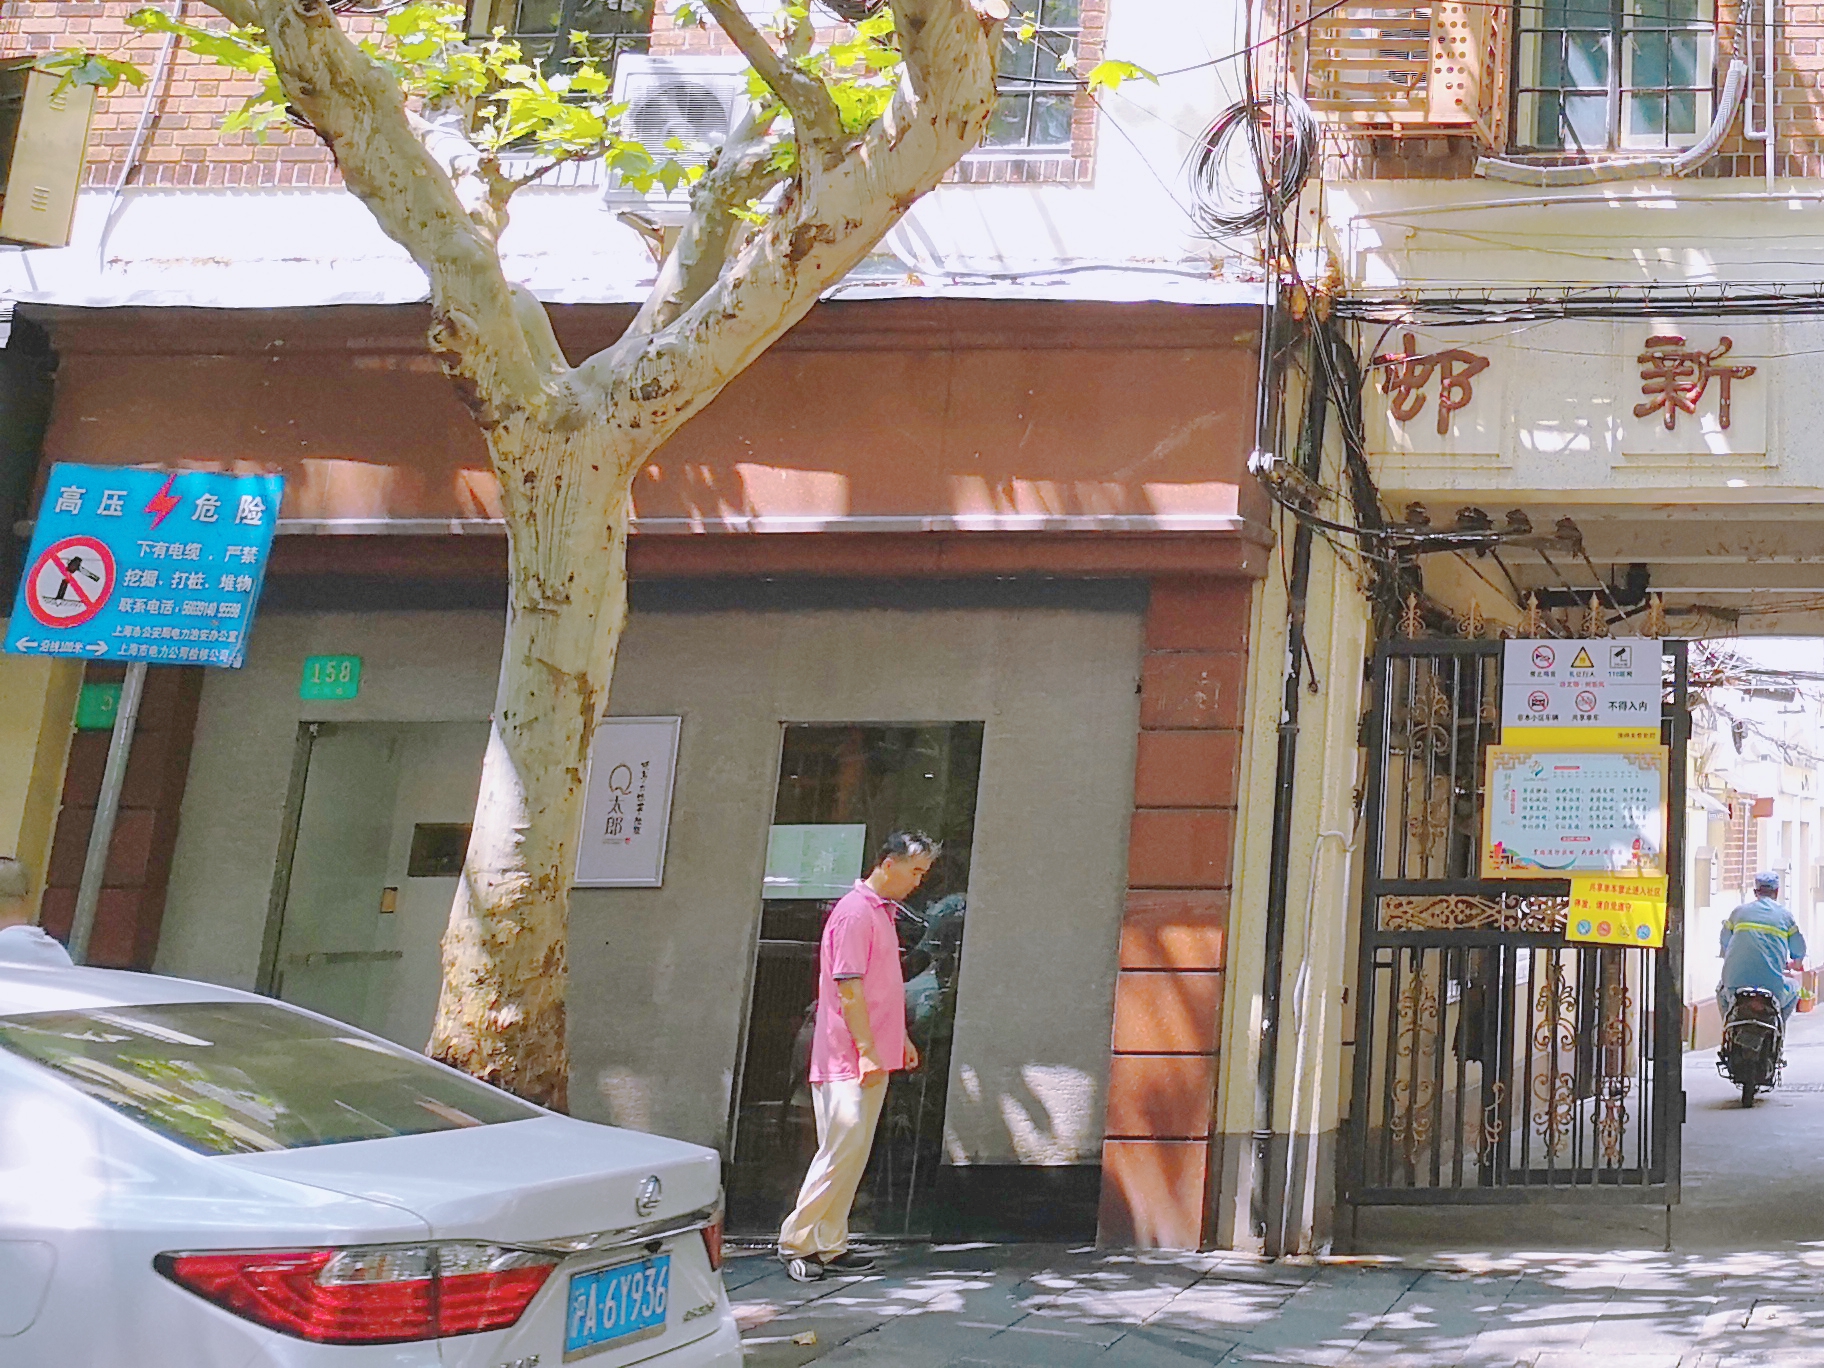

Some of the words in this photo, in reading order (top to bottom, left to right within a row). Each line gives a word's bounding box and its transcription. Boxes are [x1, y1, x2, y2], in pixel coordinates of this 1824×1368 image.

[54, 485, 129, 517] 高压
[190, 492, 268, 526] 危险
[312, 661, 352, 683] 158
[1608, 701, 1648, 712] 不得入内
